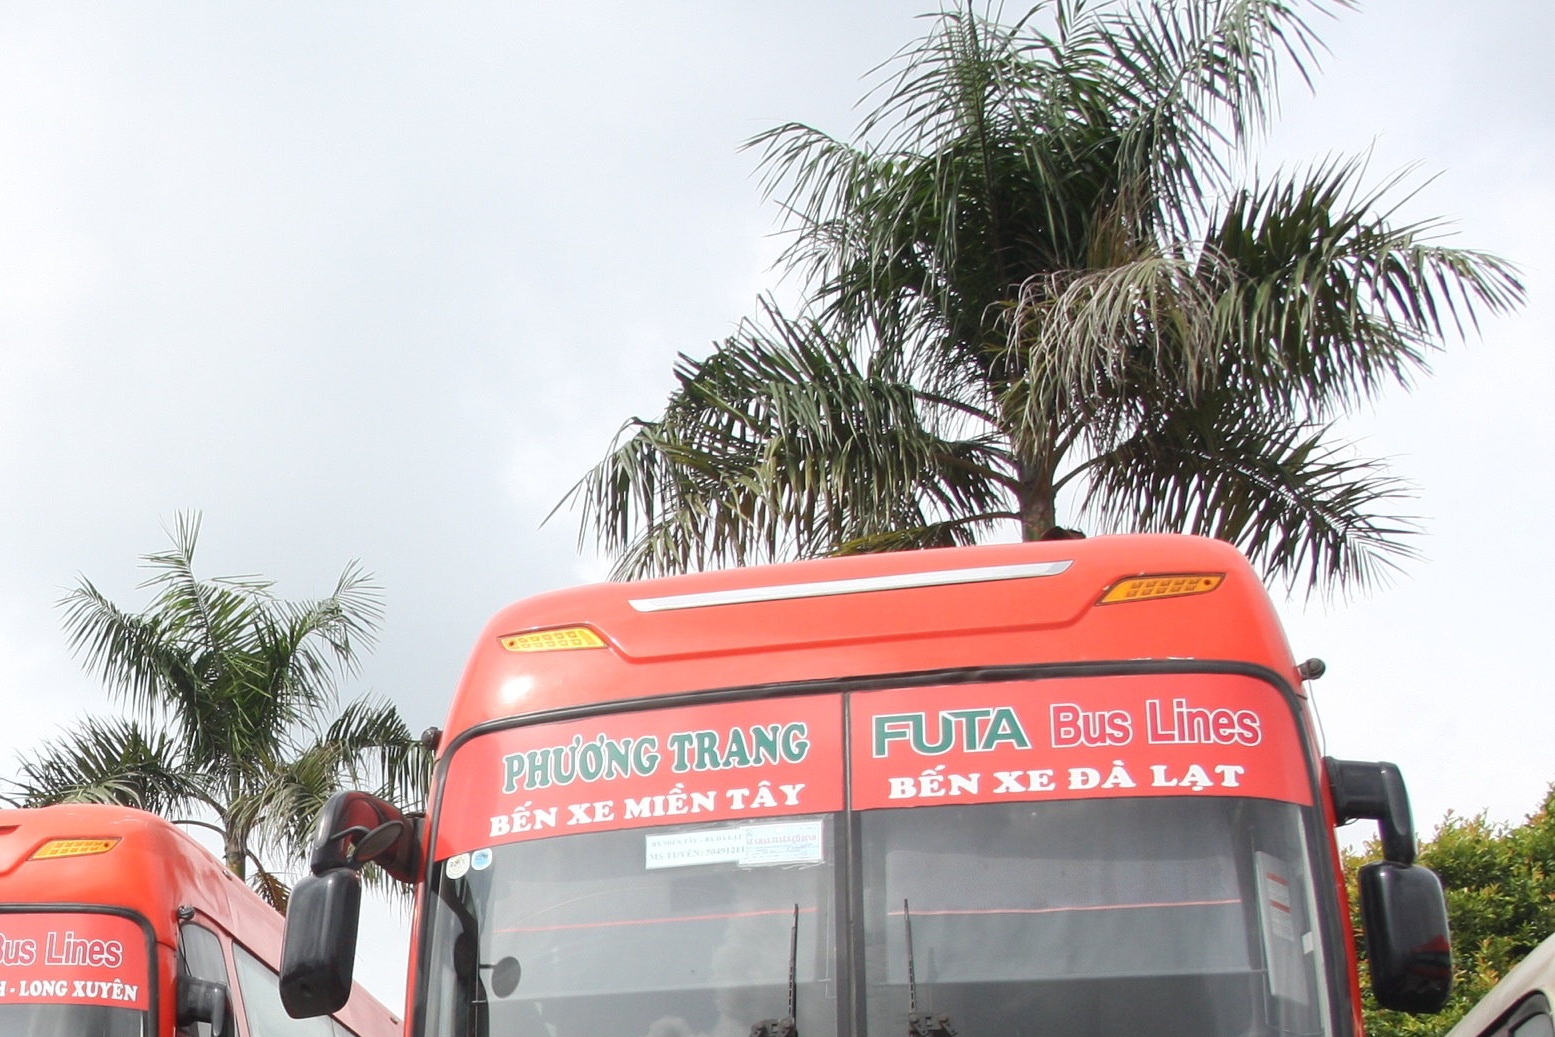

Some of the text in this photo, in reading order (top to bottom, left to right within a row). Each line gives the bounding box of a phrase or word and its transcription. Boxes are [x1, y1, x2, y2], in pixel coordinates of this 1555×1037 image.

[872, 698, 1262, 758] FUTA Bus Lines
[502, 722, 810, 793] PHƯƠNG TRANG
[888, 760, 1245, 800] BẾN XE ĐÀ LẠT
[489, 780, 806, 837] BẾN XE MIỀN TÂY
[45, 931, 123, 968] Lines
[19, 980, 69, 998] LONG
[71, 978, 138, 1002] XUYÊN
